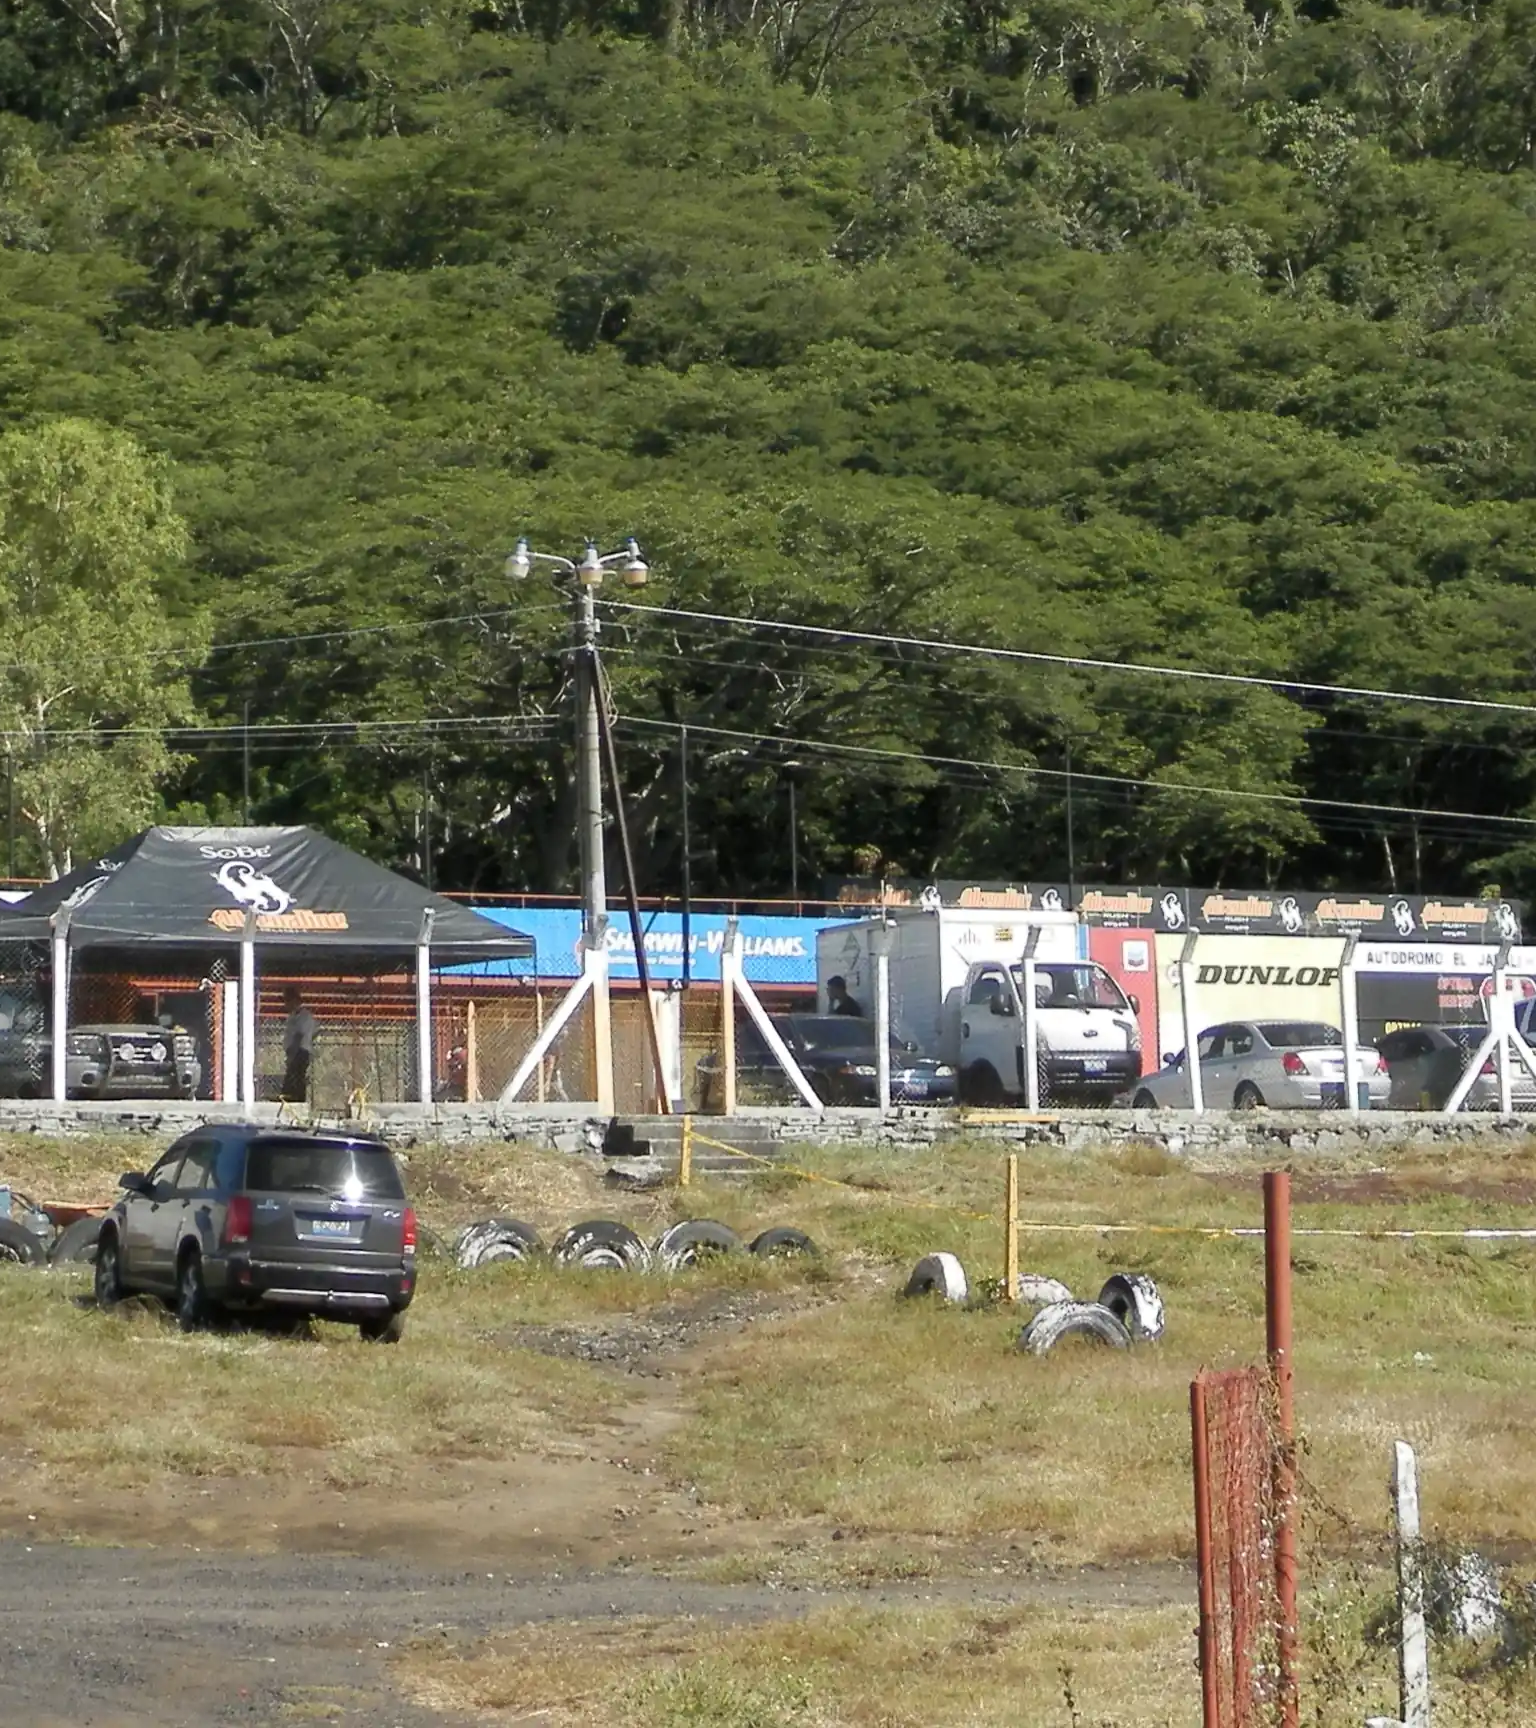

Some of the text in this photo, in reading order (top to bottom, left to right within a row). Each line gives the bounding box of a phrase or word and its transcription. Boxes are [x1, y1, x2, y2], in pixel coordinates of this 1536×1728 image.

[208, 908, 349, 931] Adenaline
[1367, 951, 1444, 966] AUTODROMO
[1453, 953, 1467, 966] EL
[1195, 964, 1340, 986] DUNLOP
